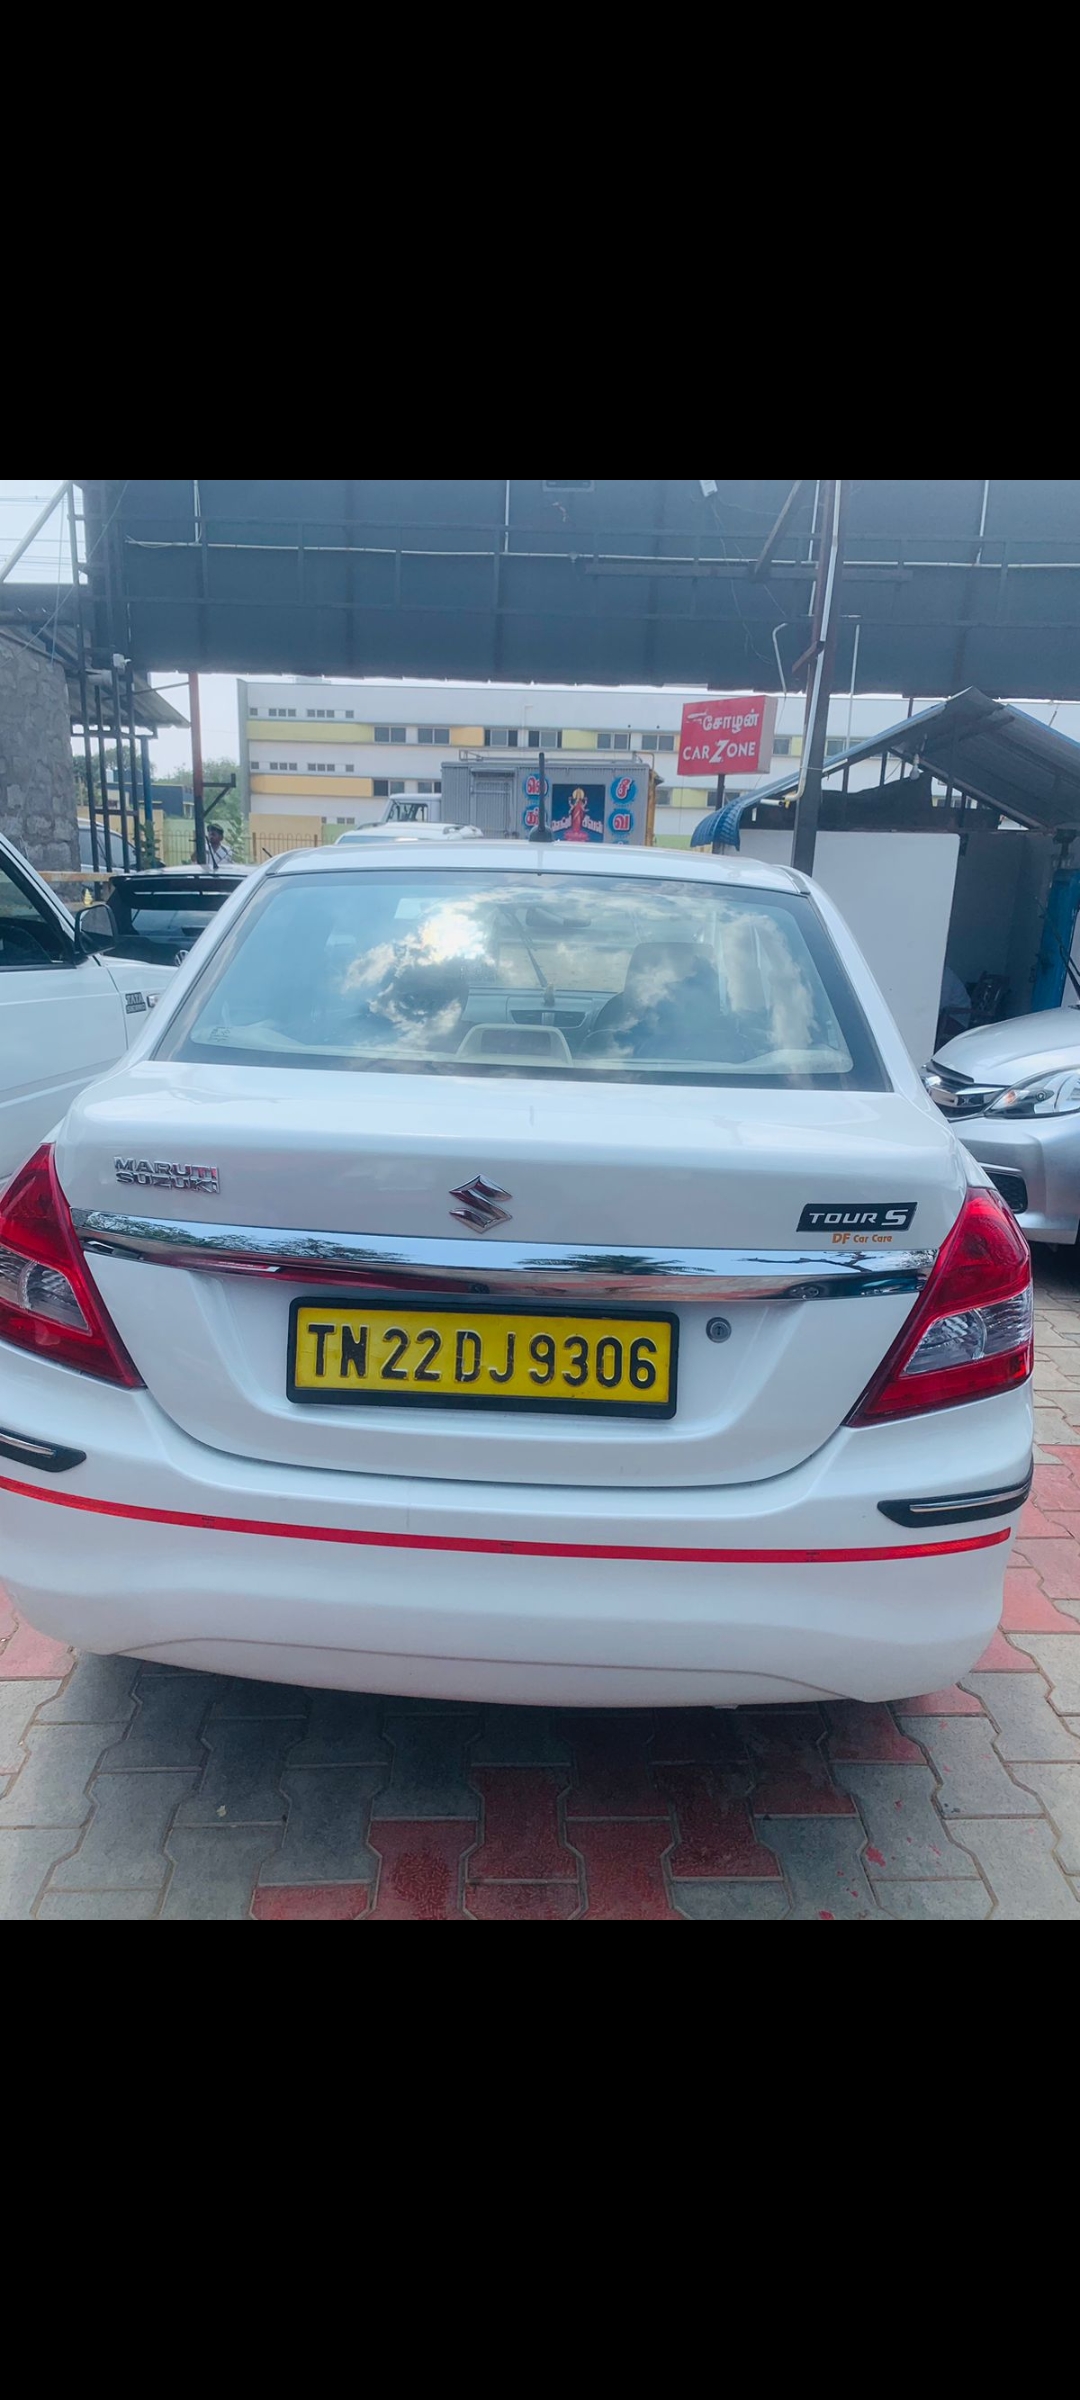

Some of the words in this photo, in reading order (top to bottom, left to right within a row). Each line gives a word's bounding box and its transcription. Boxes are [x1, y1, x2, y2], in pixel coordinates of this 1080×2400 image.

[702, 708, 760, 734] சோழன்
[683, 745, 710, 761] CAR
[113, 1156, 219, 1180] MARUTI
[116, 1171, 220, 1194] SUZUKI
[809, 1212, 878, 1224] TOUR
[881, 1209, 908, 1226] S
[832, 1233, 851, 1244] DF
[853, 1235, 869, 1243] Car
[872, 1234, 893, 1242] Care
[528, 1332, 657, 1390] 9306
